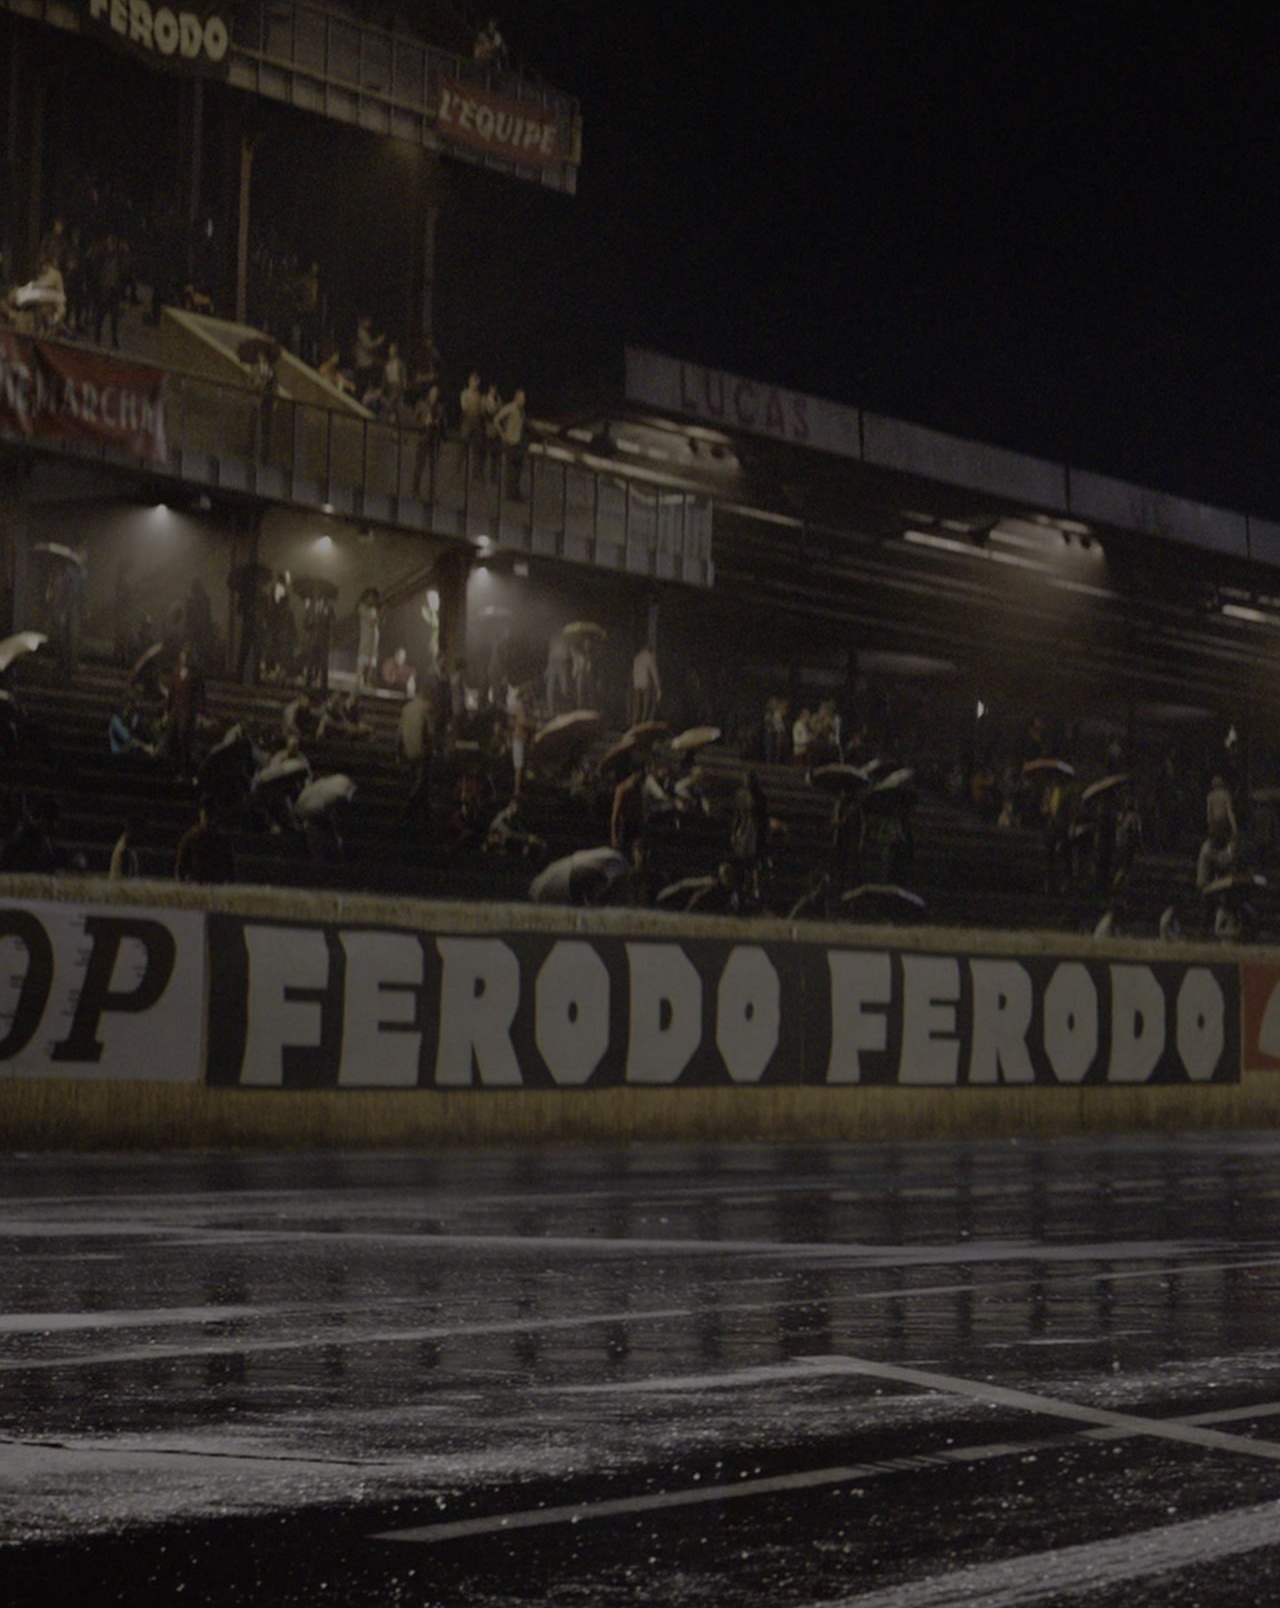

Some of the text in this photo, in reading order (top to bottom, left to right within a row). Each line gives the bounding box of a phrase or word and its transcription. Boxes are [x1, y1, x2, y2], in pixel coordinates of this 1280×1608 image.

[678, 359, 809, 439] LUCAS
[240, 923, 780, 1086] FERODO
[826, 949, 1225, 1084] FERODO
